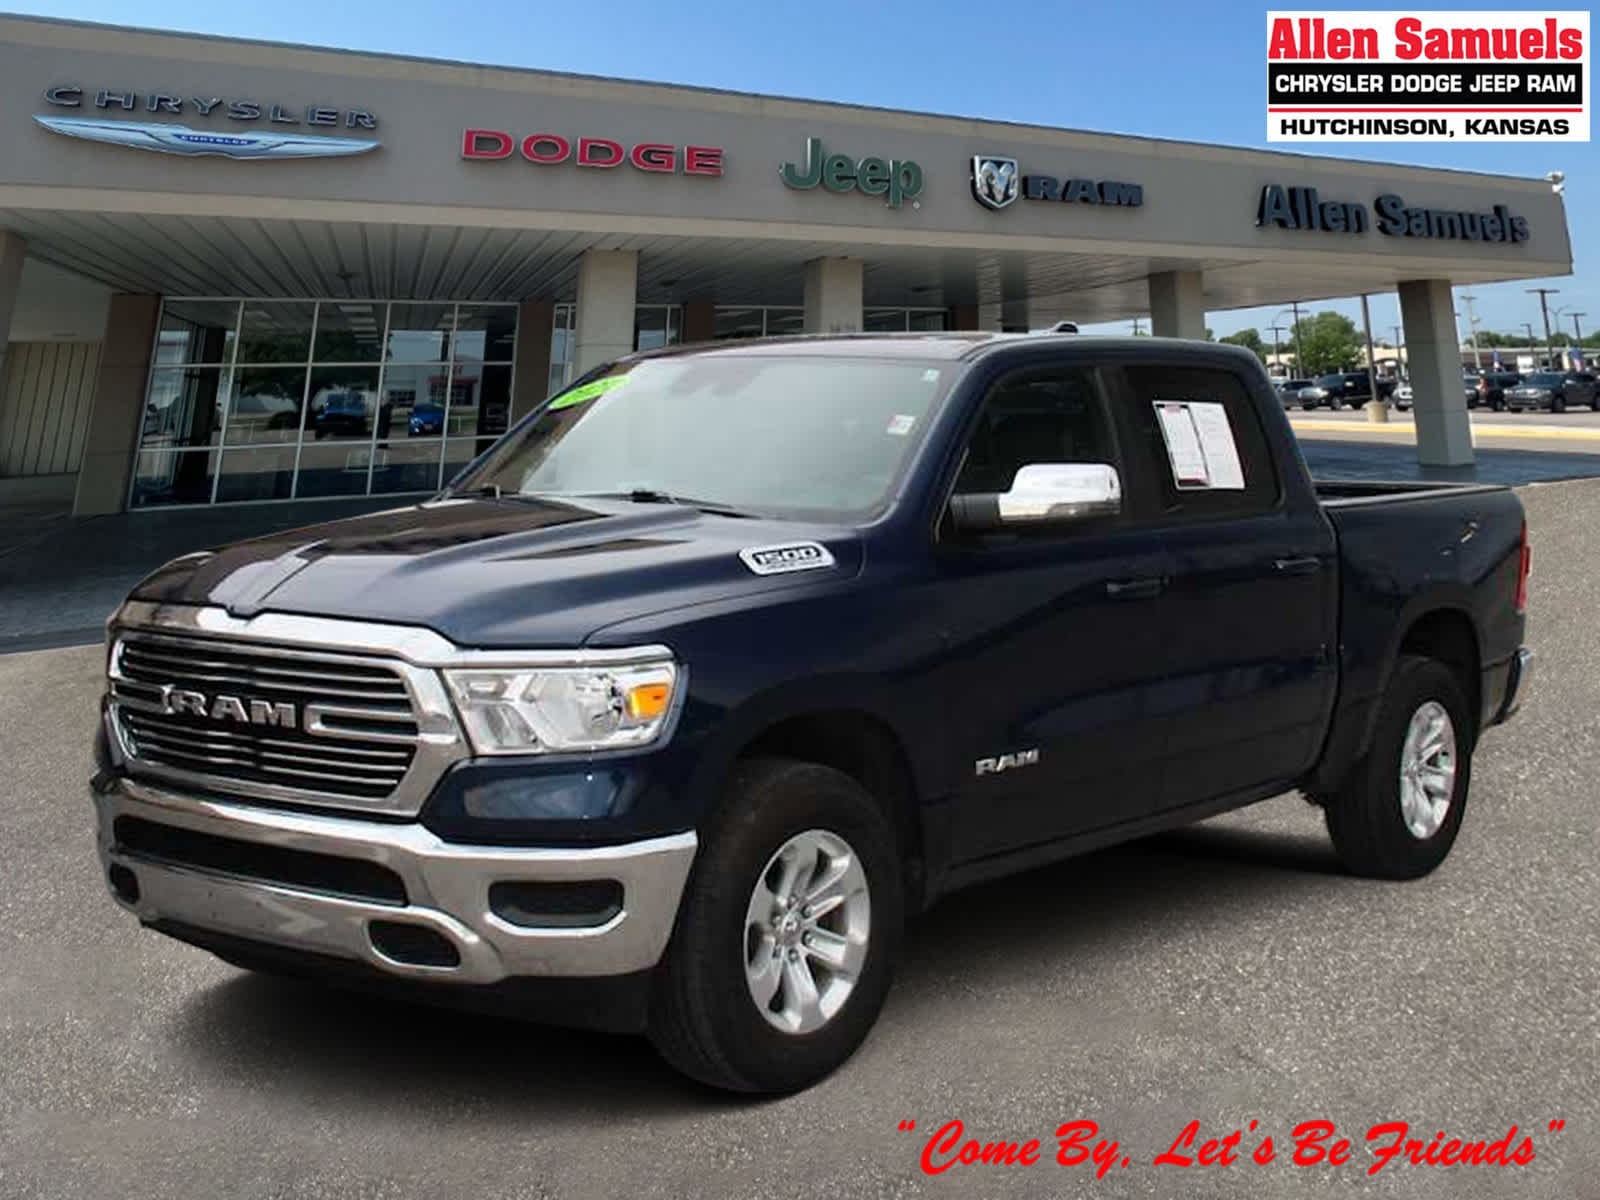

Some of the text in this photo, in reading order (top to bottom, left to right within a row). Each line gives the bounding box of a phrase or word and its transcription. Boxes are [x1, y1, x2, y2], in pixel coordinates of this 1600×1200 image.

[45, 86, 378, 129] CHRYSLER
[462, 129, 724, 176] DODGE
[779, 137, 922, 208] Jeep
[1023, 175, 1143, 207] RAM
[1255, 184, 1530, 243] Allen Samuels
[756, 546, 818, 567] 1500
[171, 689, 296, 728] RAM
[975, 748, 1039, 776] RAM
